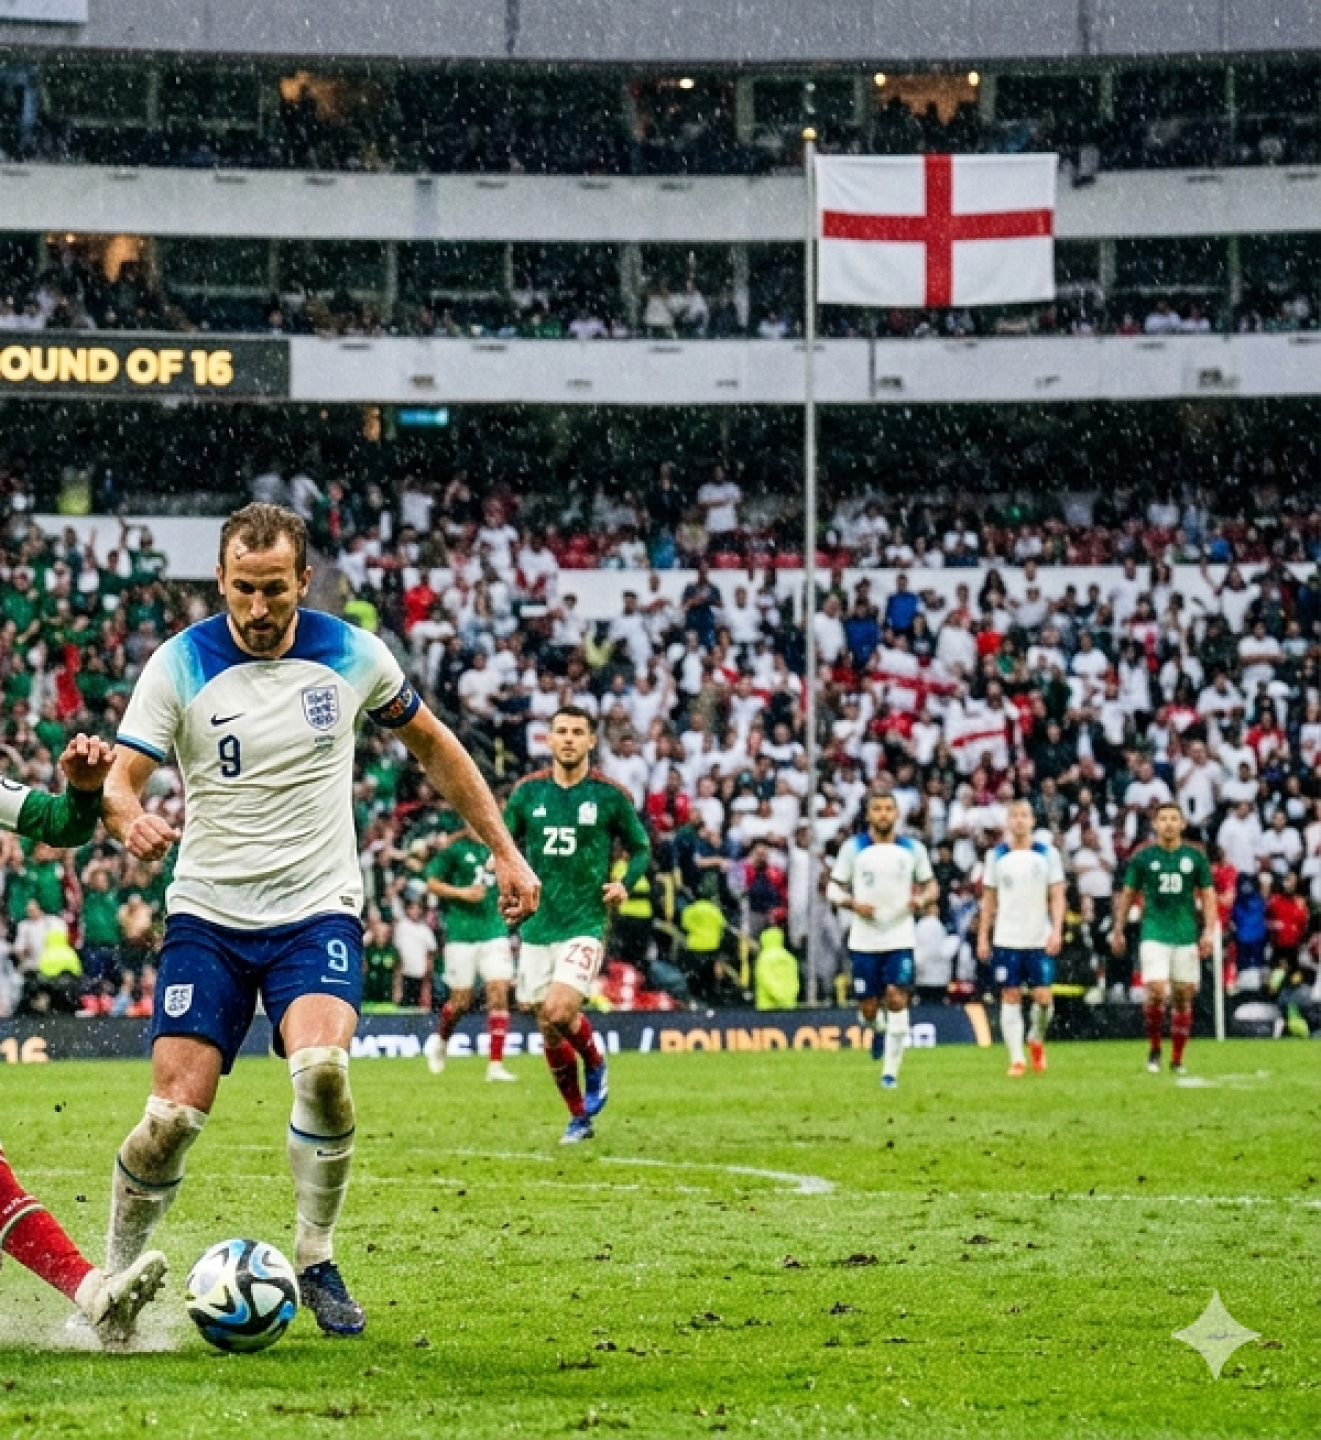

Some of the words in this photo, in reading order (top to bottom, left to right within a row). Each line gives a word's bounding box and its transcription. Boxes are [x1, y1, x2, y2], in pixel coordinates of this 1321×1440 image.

[125, 347, 185, 385] OF
[190, 349, 235, 387] 16
[218, 734, 242, 778] 9
[543, 826, 577, 855] 25
[326, 938, 349, 972] 9
